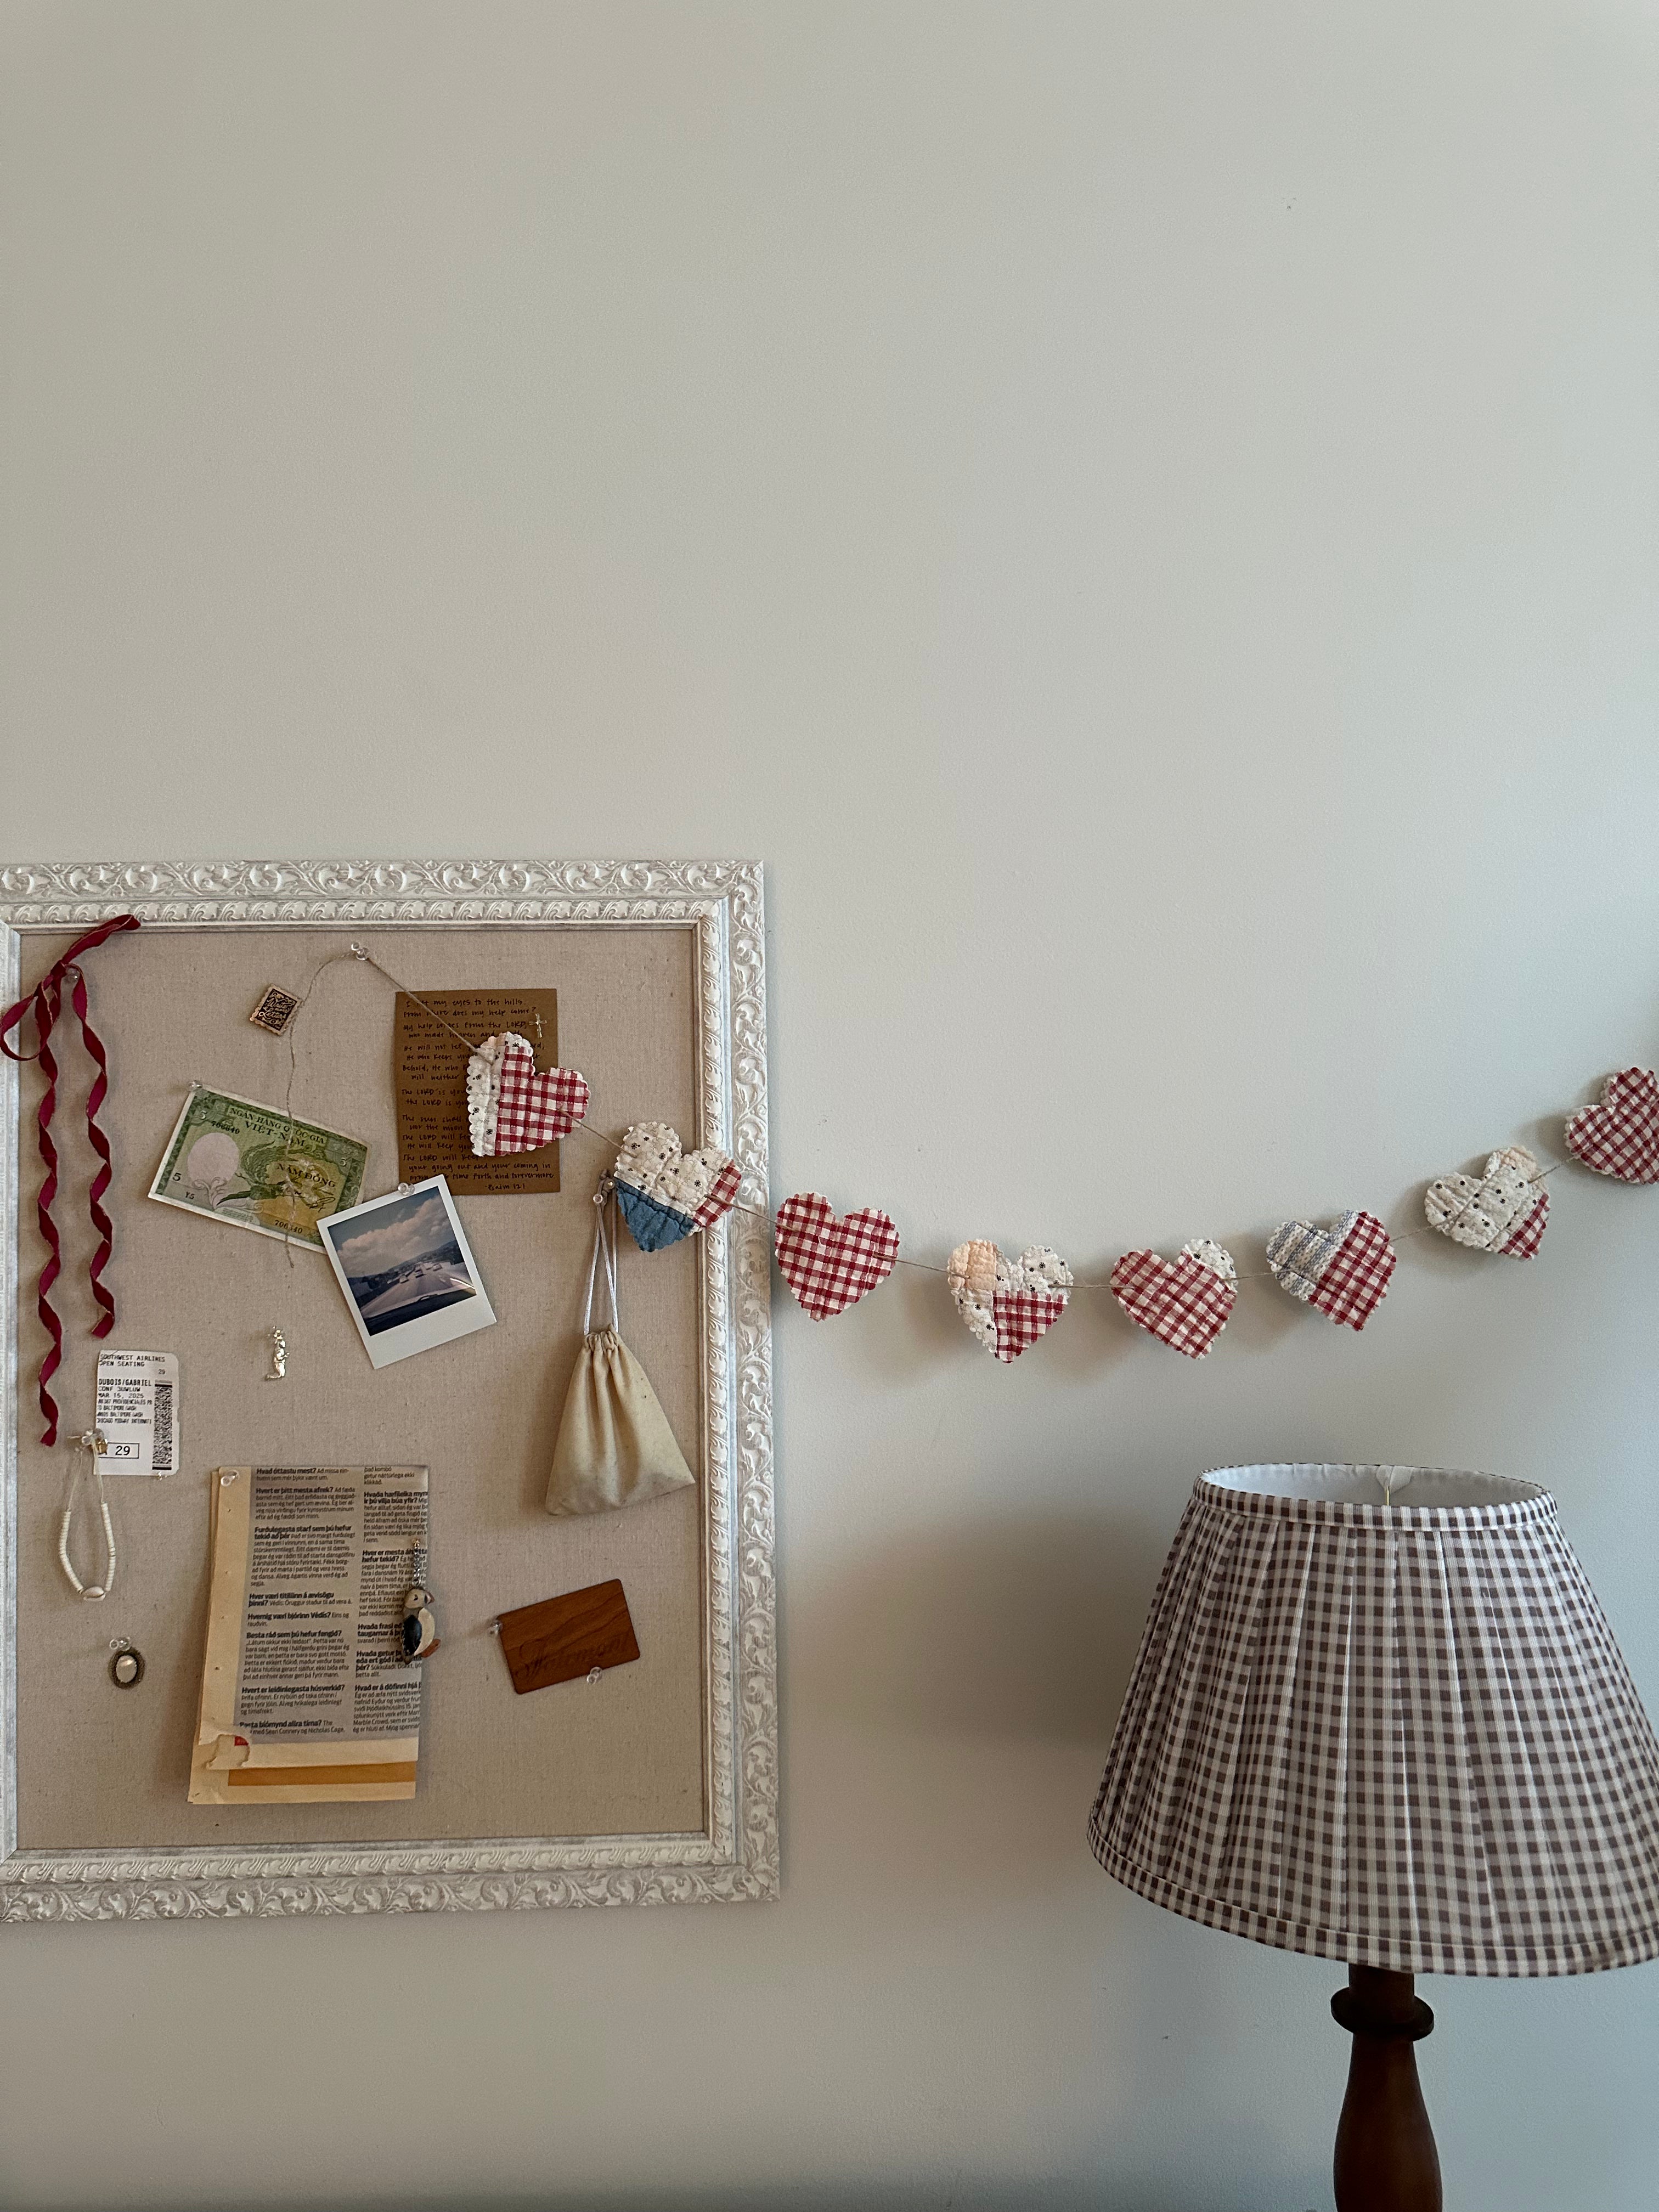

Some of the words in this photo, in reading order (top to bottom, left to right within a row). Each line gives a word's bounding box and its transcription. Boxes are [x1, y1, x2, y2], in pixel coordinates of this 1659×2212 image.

[199, 1110, 207, 1119] 5
[432, 1164, 453, 1172] going
[492, 1163, 511, 1172] your
[514, 1163, 539, 1171] coming
[172, 1172, 182, 1181] 5
[274, 1219, 303, 1234] 70640
[98, 1378, 152, 1387] DUBOIS/GABRIEL
[115, 1445, 131, 1456] 29
